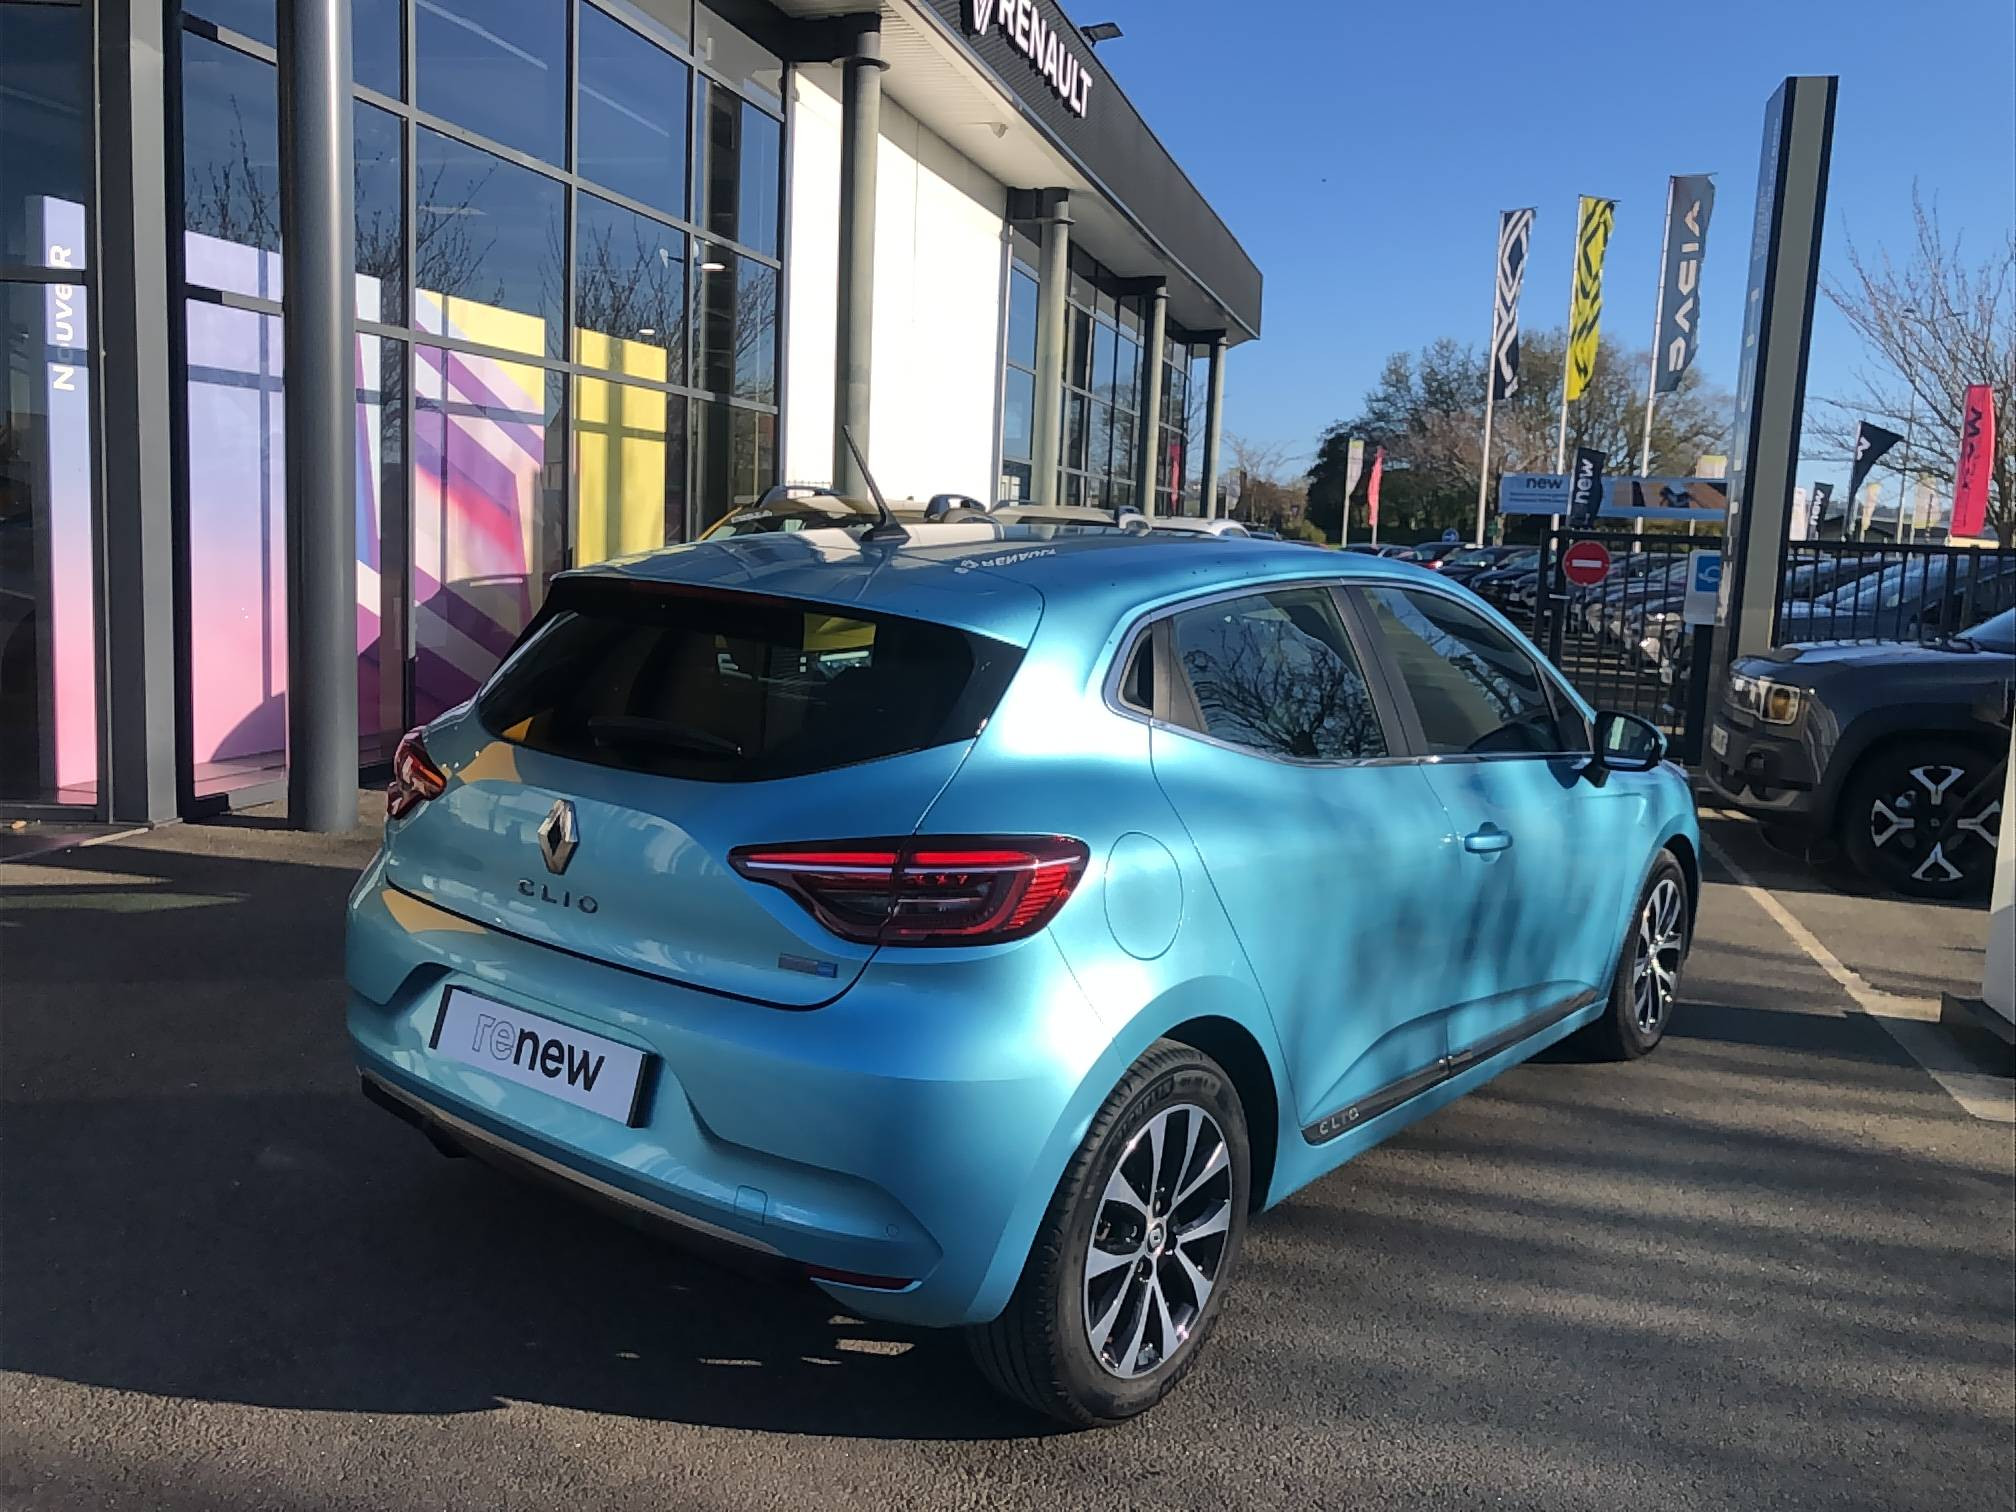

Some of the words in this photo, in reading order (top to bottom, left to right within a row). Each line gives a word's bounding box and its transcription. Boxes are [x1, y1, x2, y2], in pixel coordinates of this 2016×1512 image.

[998, 0, 1093, 118] RENAULT
[1669, 200, 1701, 371] DACIA
[1576, 458, 1594, 504] new
[518, 878, 599, 914] CLIO
[471, 1013, 606, 1093] renew
[1320, 1107, 1360, 1135] CLIO
